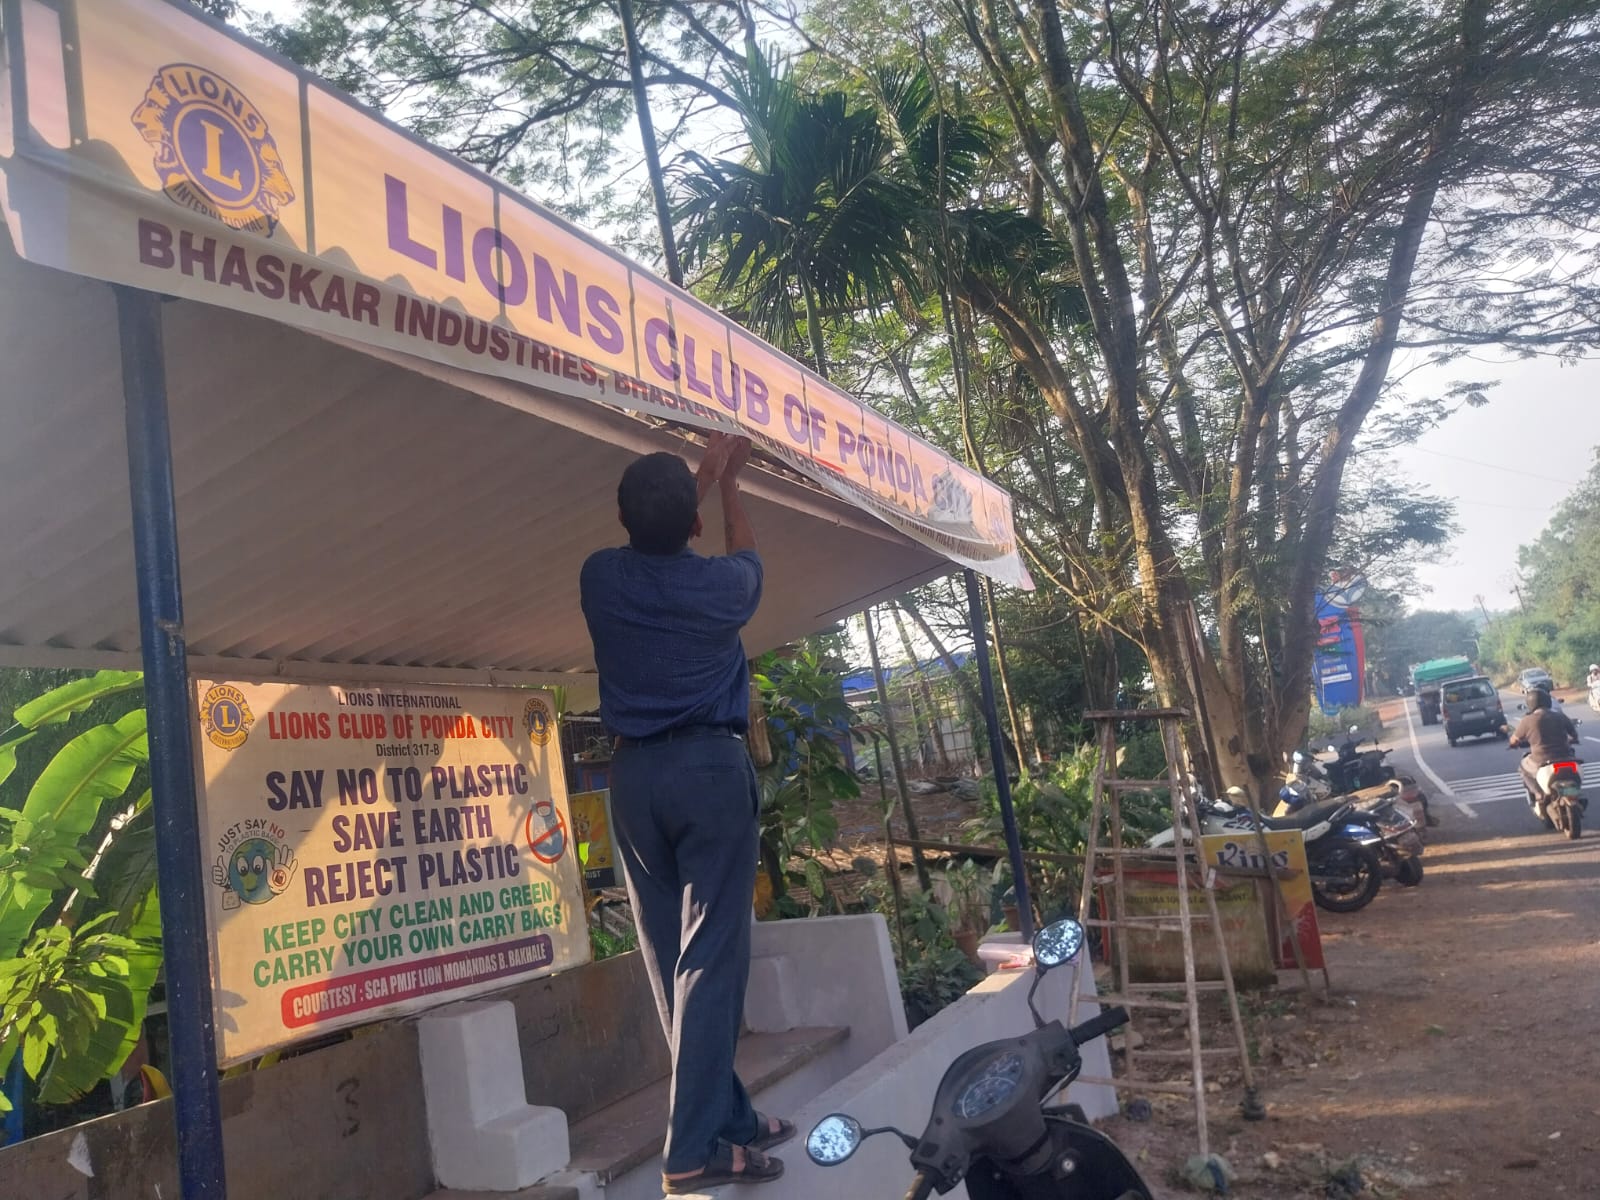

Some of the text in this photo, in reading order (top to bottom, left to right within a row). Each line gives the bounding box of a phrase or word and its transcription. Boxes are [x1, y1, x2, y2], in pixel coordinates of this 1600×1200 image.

[169, 72, 261, 133] LIONS
[200, 120, 243, 192] L
[137, 218, 381, 327] BHASKAR
[394, 294, 606, 395] INDUSTRIES,
[384, 172, 625, 355] LIONS
[645, 317, 771, 426] CLUB
[784, 393, 827, 452] OF
[836, 420, 929, 503] PONDA
[208, 687, 242, 702] LIONS
[220, 705, 236, 728] L
[338, 692, 462, 709] LIONS INTERNATIONAL
[267, 711, 332, 740] LIONS
[338, 713, 387, 740] CLUB
[393, 714, 414, 740] OF
[420, 714, 478, 739] PONDA
[481, 716, 514, 739] CITY
[376, 743, 440, 757] District 317-B
[266, 763, 529, 812] SAY NO TO PLASTIC
[217, 819, 285, 853] JUST SAY NO
[331, 810, 405, 853] SAVE
[412, 805, 493, 845] EARTH
[304, 843, 520, 908] REJECT PLASTIC
[263, 881, 553, 954] KEEP CITY CLEAN AND GREEN
[253, 903, 563, 988] CARRY YOUR OWN CARRY BAGS
[293, 983, 357, 1019] COURTESY
[364, 977, 389, 1000] SCA
[389, 970, 419, 995] PMJF
[419, 968, 443, 988] LION
[443, 955, 498, 982] MOHANDAS
[498, 952, 509, 971] B.
[508, 943, 547, 968] BAKHALE
